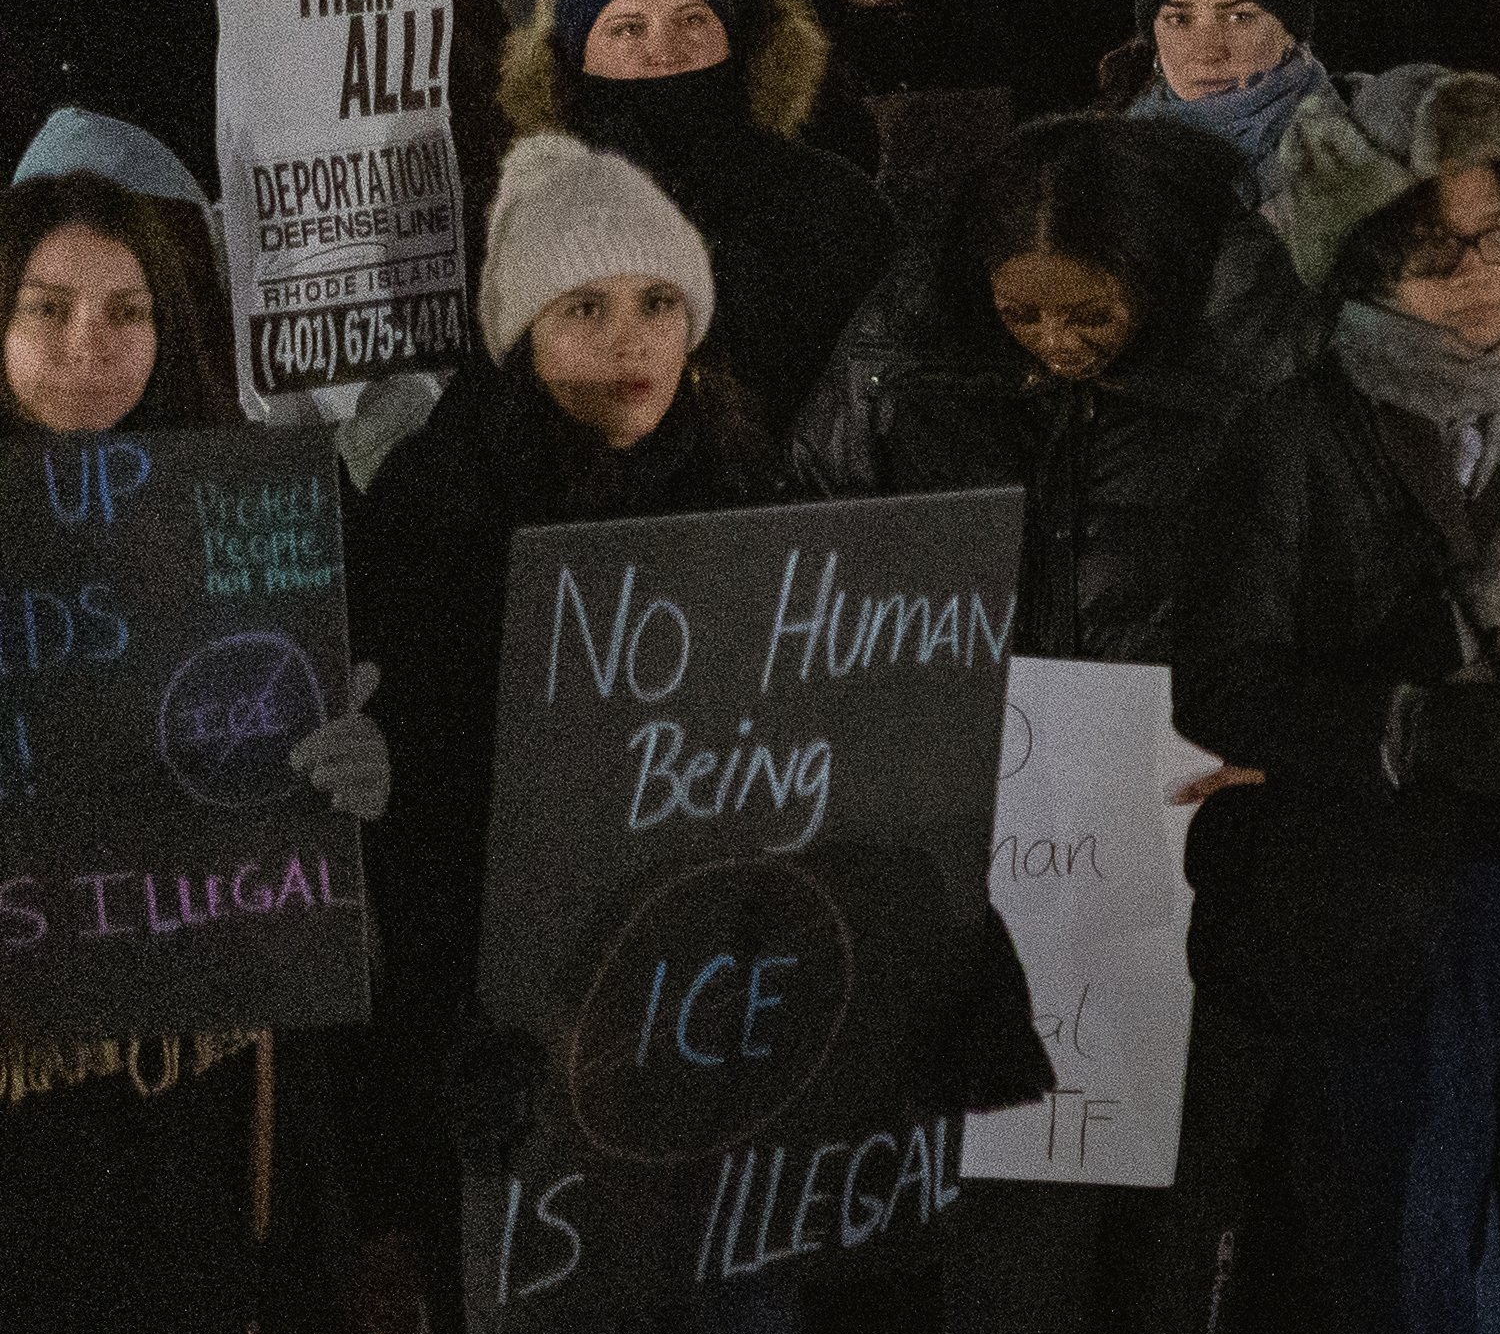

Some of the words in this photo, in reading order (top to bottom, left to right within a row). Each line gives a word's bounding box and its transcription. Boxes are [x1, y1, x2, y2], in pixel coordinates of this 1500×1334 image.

[340, 8, 445, 120] ALL!
[253, 135, 450, 221] DEPORTATION
[260, 210, 389, 252] DEFENSE
[395, 205, 449, 239] LINE
[263, 275, 357, 310] RHODE
[368, 259, 456, 291] ISLAND
[260, 313, 338, 390] (401)
[44, 440, 150, 525] UP
[0, 582, 130, 671] DS
[73, 856, 360, 938] ILLEGAL
[636, 954, 798, 1069] ICE
[497, 1172, 586, 1307] IS
[695, 1116, 961, 1284] ILLEGAL
